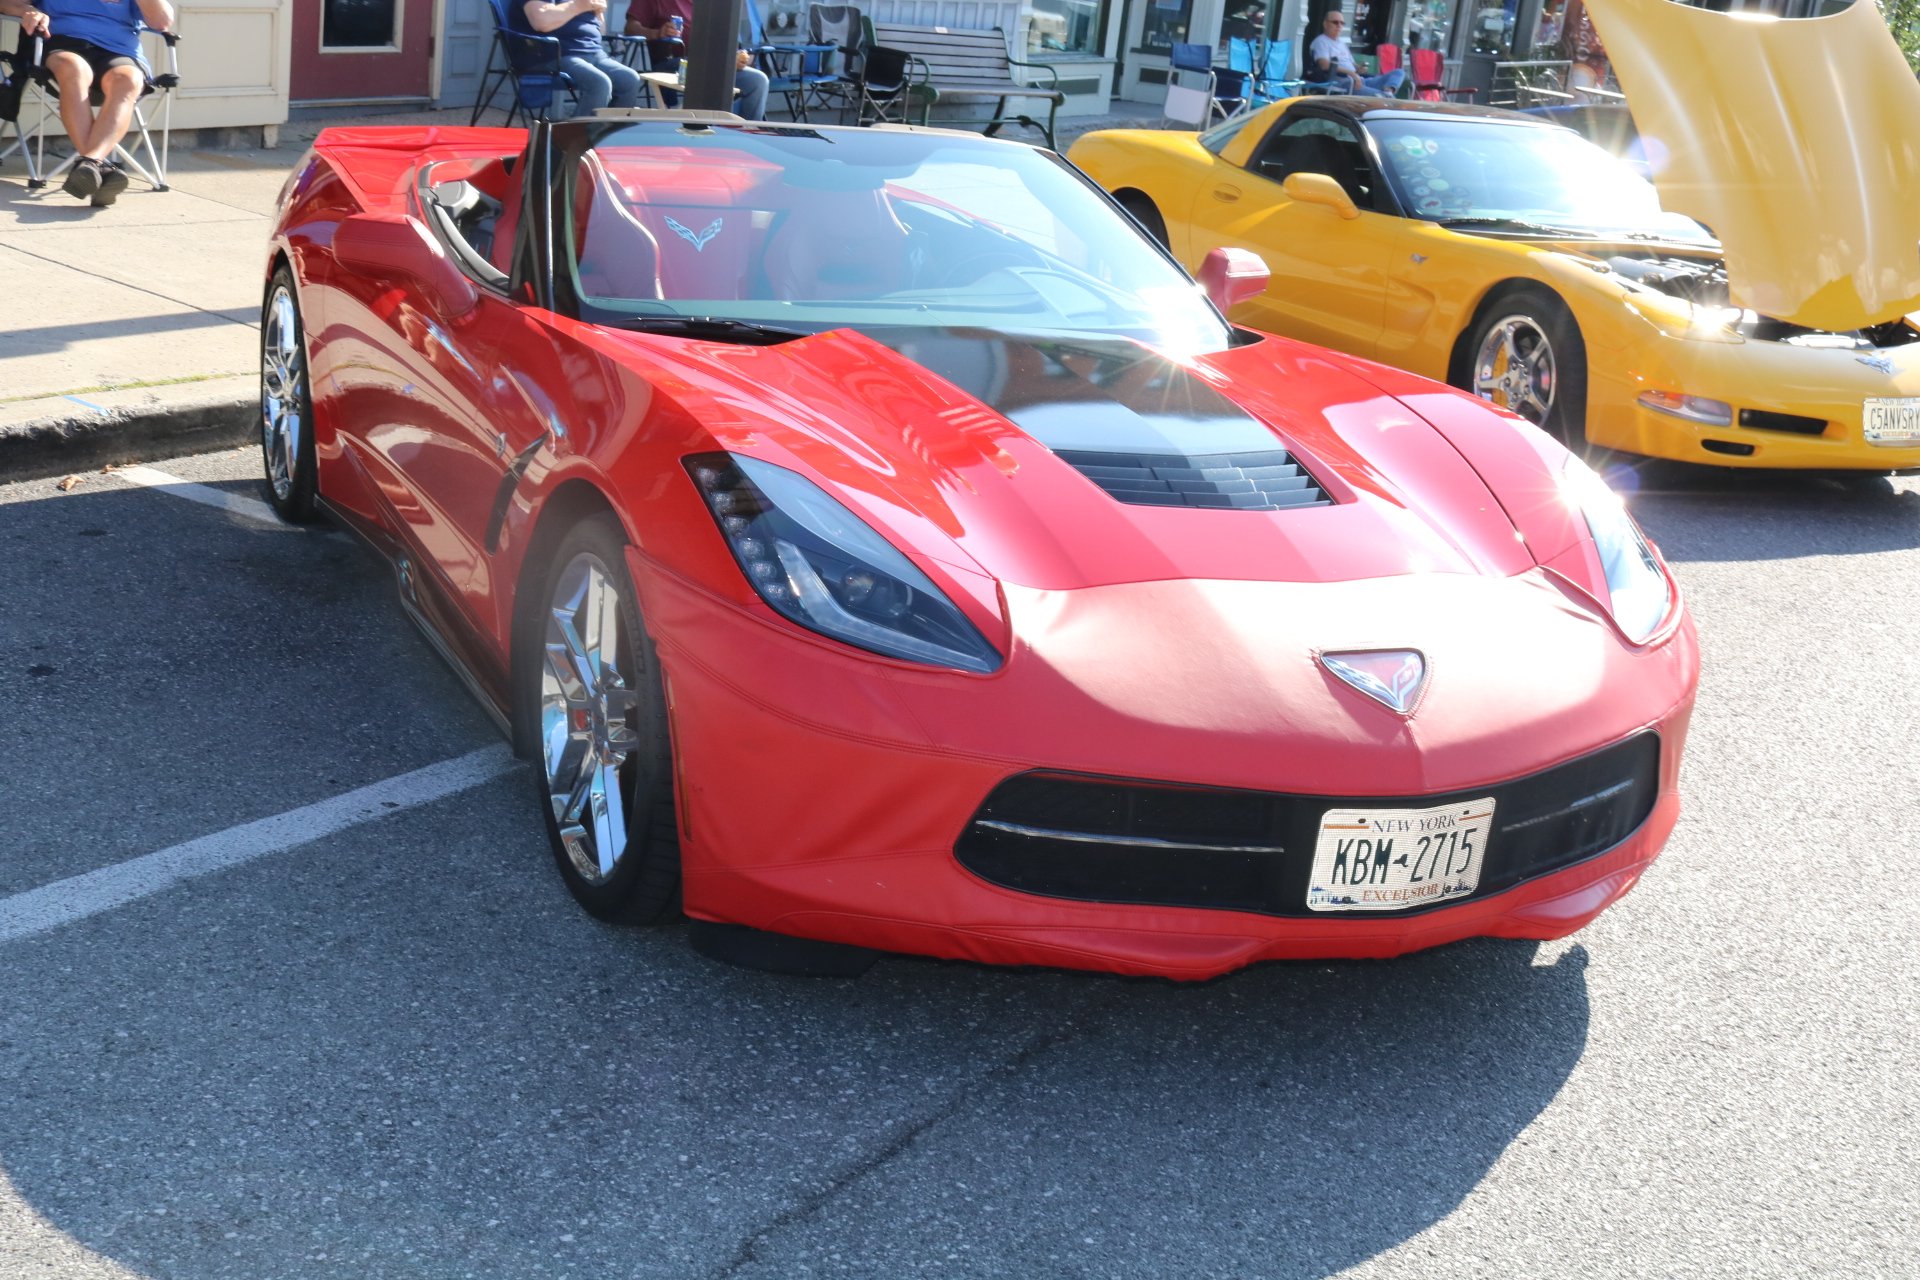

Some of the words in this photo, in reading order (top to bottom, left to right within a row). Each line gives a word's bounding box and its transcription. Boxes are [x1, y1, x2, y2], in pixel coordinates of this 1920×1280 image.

[1871, 407, 1920, 430] C5ANVSRY
[1372, 819, 1414, 833] NEW
[1419, 814, 1457, 830] YORK
[1362, 883, 1439, 901] EXCELSIOR
